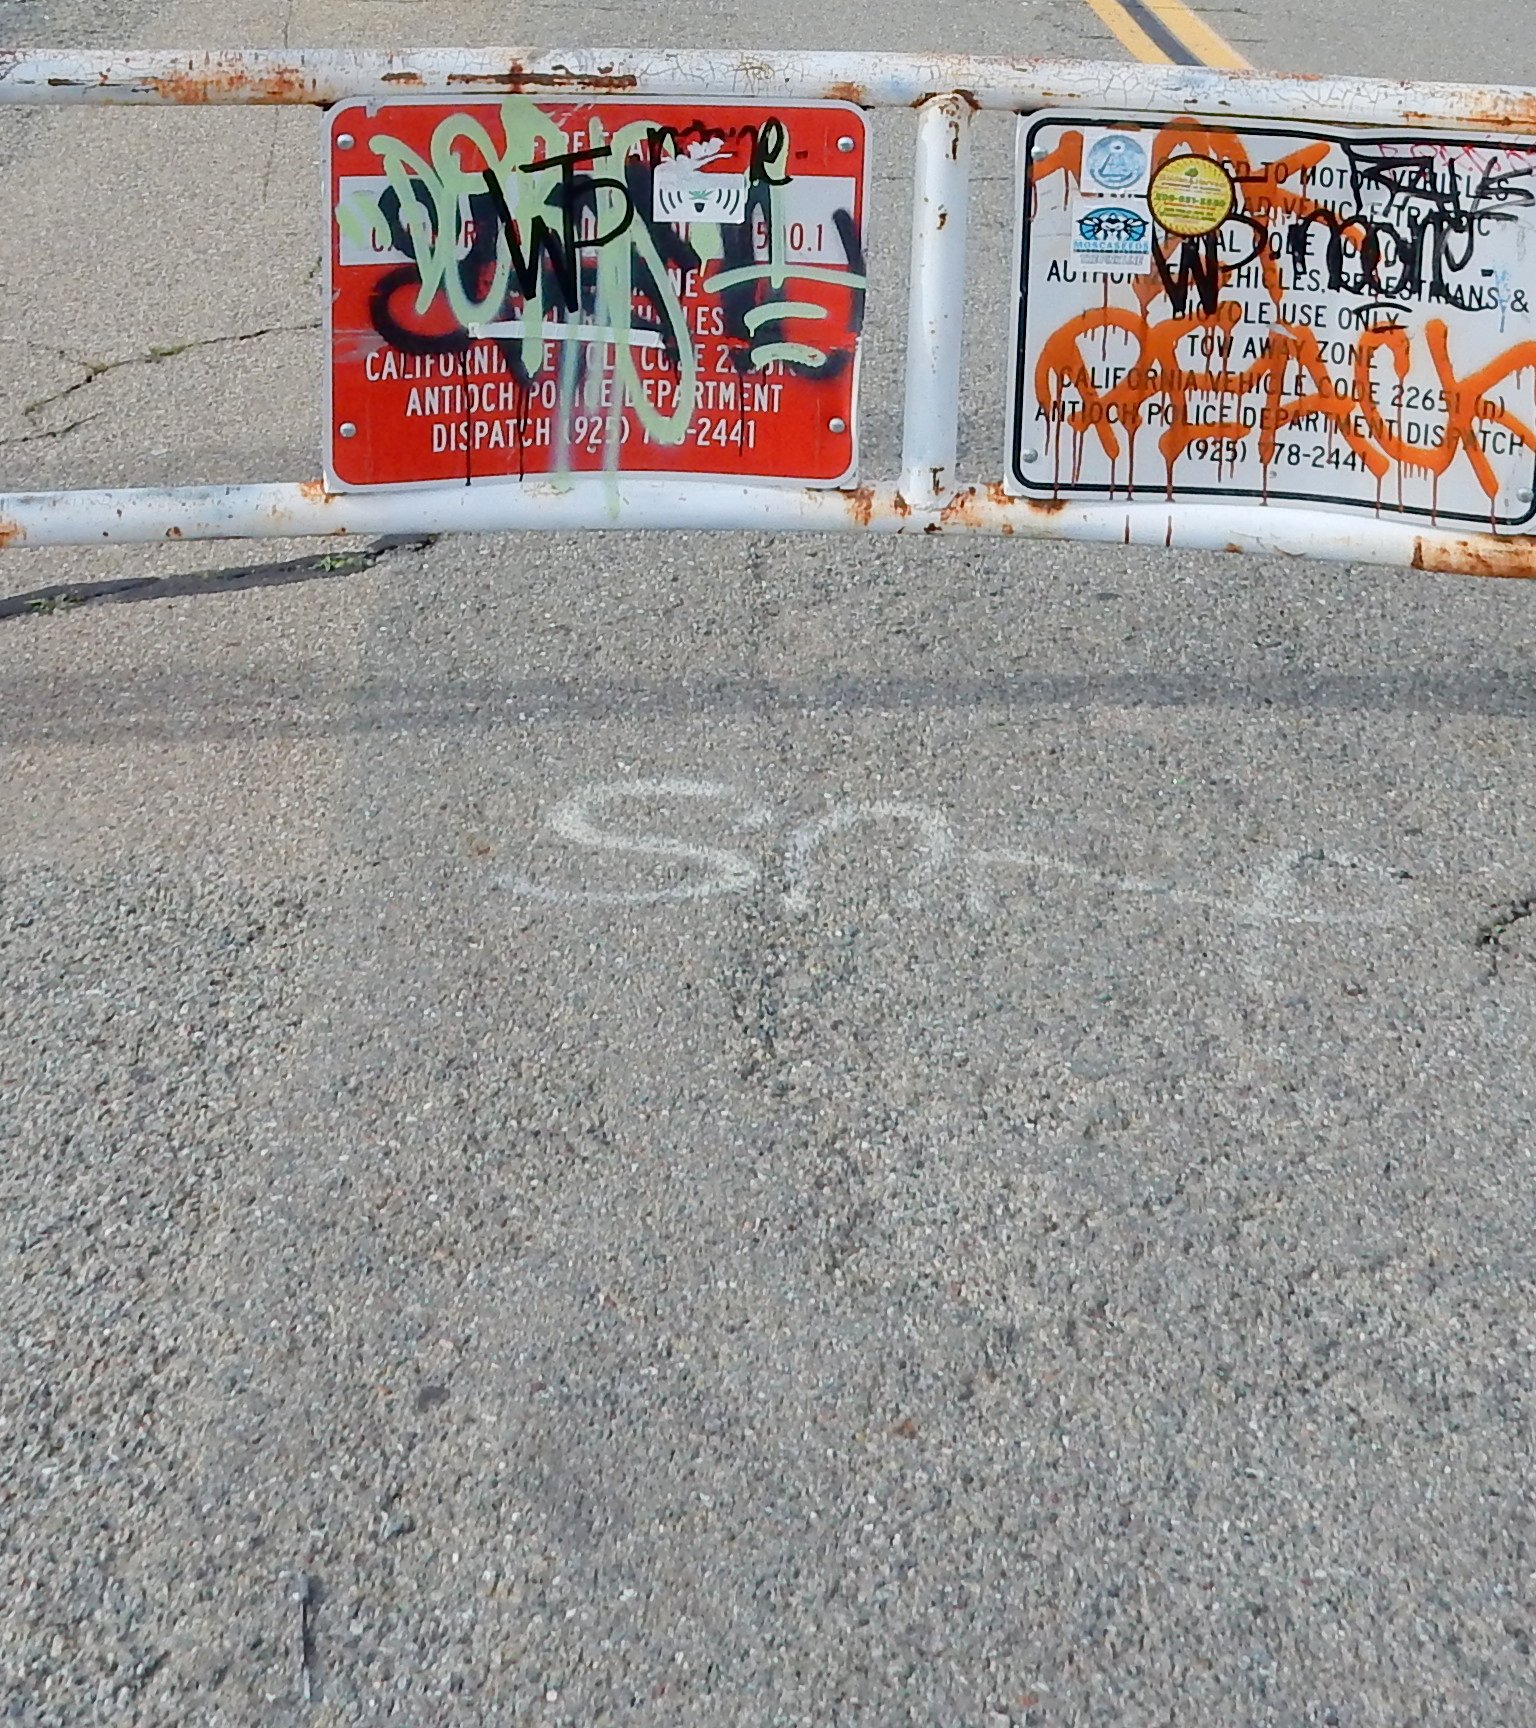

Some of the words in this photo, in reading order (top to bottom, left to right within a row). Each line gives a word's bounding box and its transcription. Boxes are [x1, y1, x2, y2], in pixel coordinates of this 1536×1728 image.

[1282, 303, 1328, 328] USE
[1338, 306, 1401, 332] ONLY
[1510, 289, 1531, 314] &
[1187, 334, 1234, 358] TOW
[1316, 340, 1378, 369] ZONE
[405, 381, 515, 417] ANTIOCH
[1061, 366, 1199, 392] CALIFORNIA
[1209, 370, 1307, 397] VEHICLE
[1318, 377, 1381, 405] CODE
[1390, 384, 1461, 415] 22651
[1473, 393, 1506, 419] (n)
[432, 417, 551, 453] DISPATCH
[1034, 400, 1139, 424] ANTIOCH
[1147, 402, 1232, 426] POLICE
[1243, 405, 1399, 442] DEPARTMENT
[1407, 421, 1526, 457] DISPATCH
[1186, 439, 1247, 463] (925)
